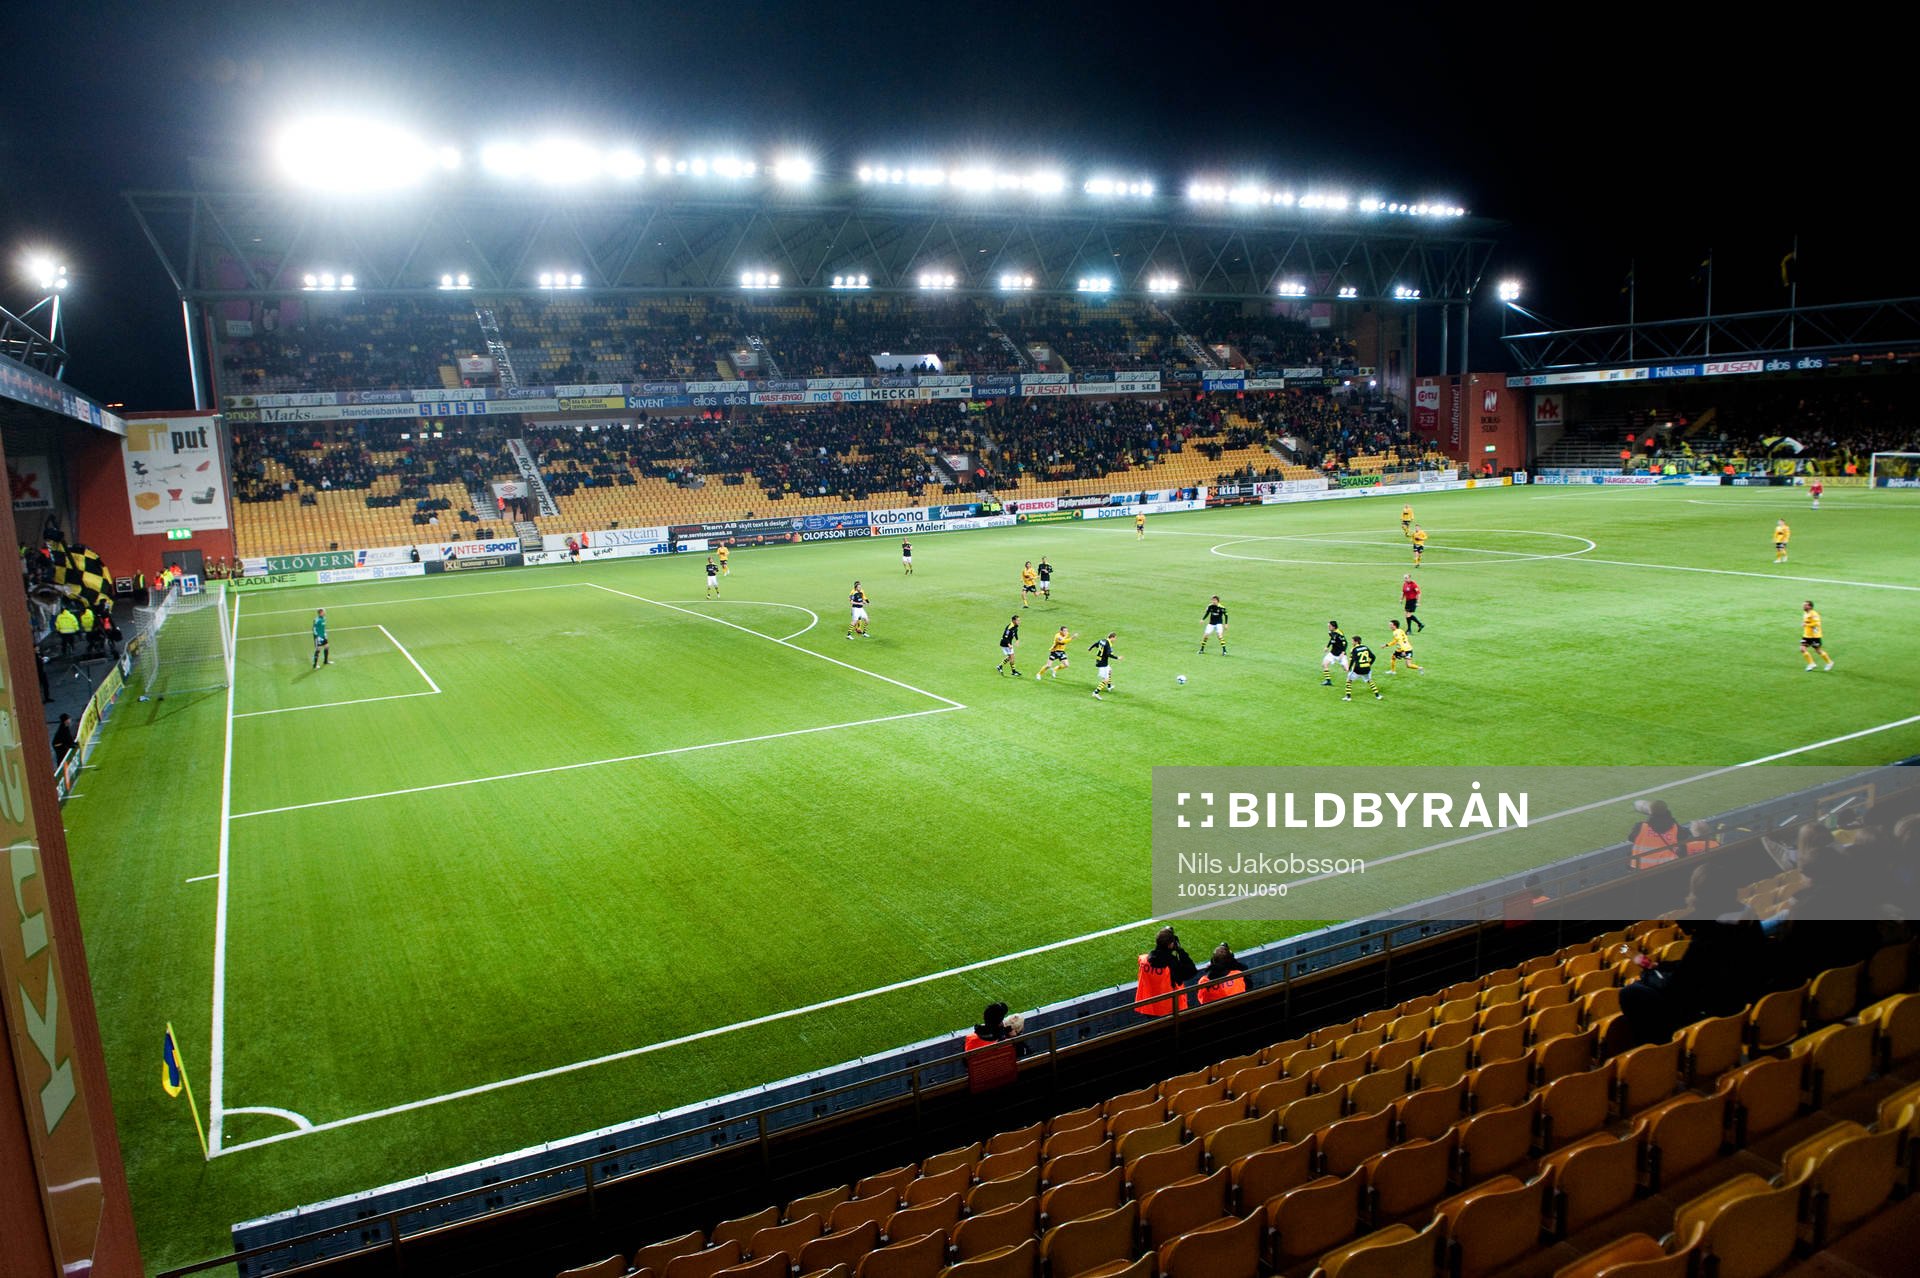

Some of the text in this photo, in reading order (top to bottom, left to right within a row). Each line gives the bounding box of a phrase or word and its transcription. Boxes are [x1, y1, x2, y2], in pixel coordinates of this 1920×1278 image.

[1706, 361, 1760, 374] PULSEN
[1766, 359, 1791, 371] ellos
[1796, 357, 1823, 369] ellos
[1656, 366, 1695, 378] Folksam
[1024, 386, 1067, 395] PULSEN
[1209, 381, 1239, 390] Folksam
[693, 394, 717, 406] ellos
[724, 393, 747, 406] ellos
[871, 389, 916, 399] MECKA
[629, 396, 665, 409] SILVENT
[225, 410, 258, 421] onyx
[263, 408, 311, 422] Marks
[342, 407, 415, 418] Handelsbanken
[1341, 476, 1380, 487] SKANSKA
[1005, 501, 1055, 513] HGBERGS
[870, 511, 924, 524] kabona
[803, 527, 871, 540] OLOFSSON BYGG
[874, 521, 946, 536] Kimmos Måleri
[454, 542, 518, 555] INTERSPORT
[268, 554, 354, 570] KLÖVERN
